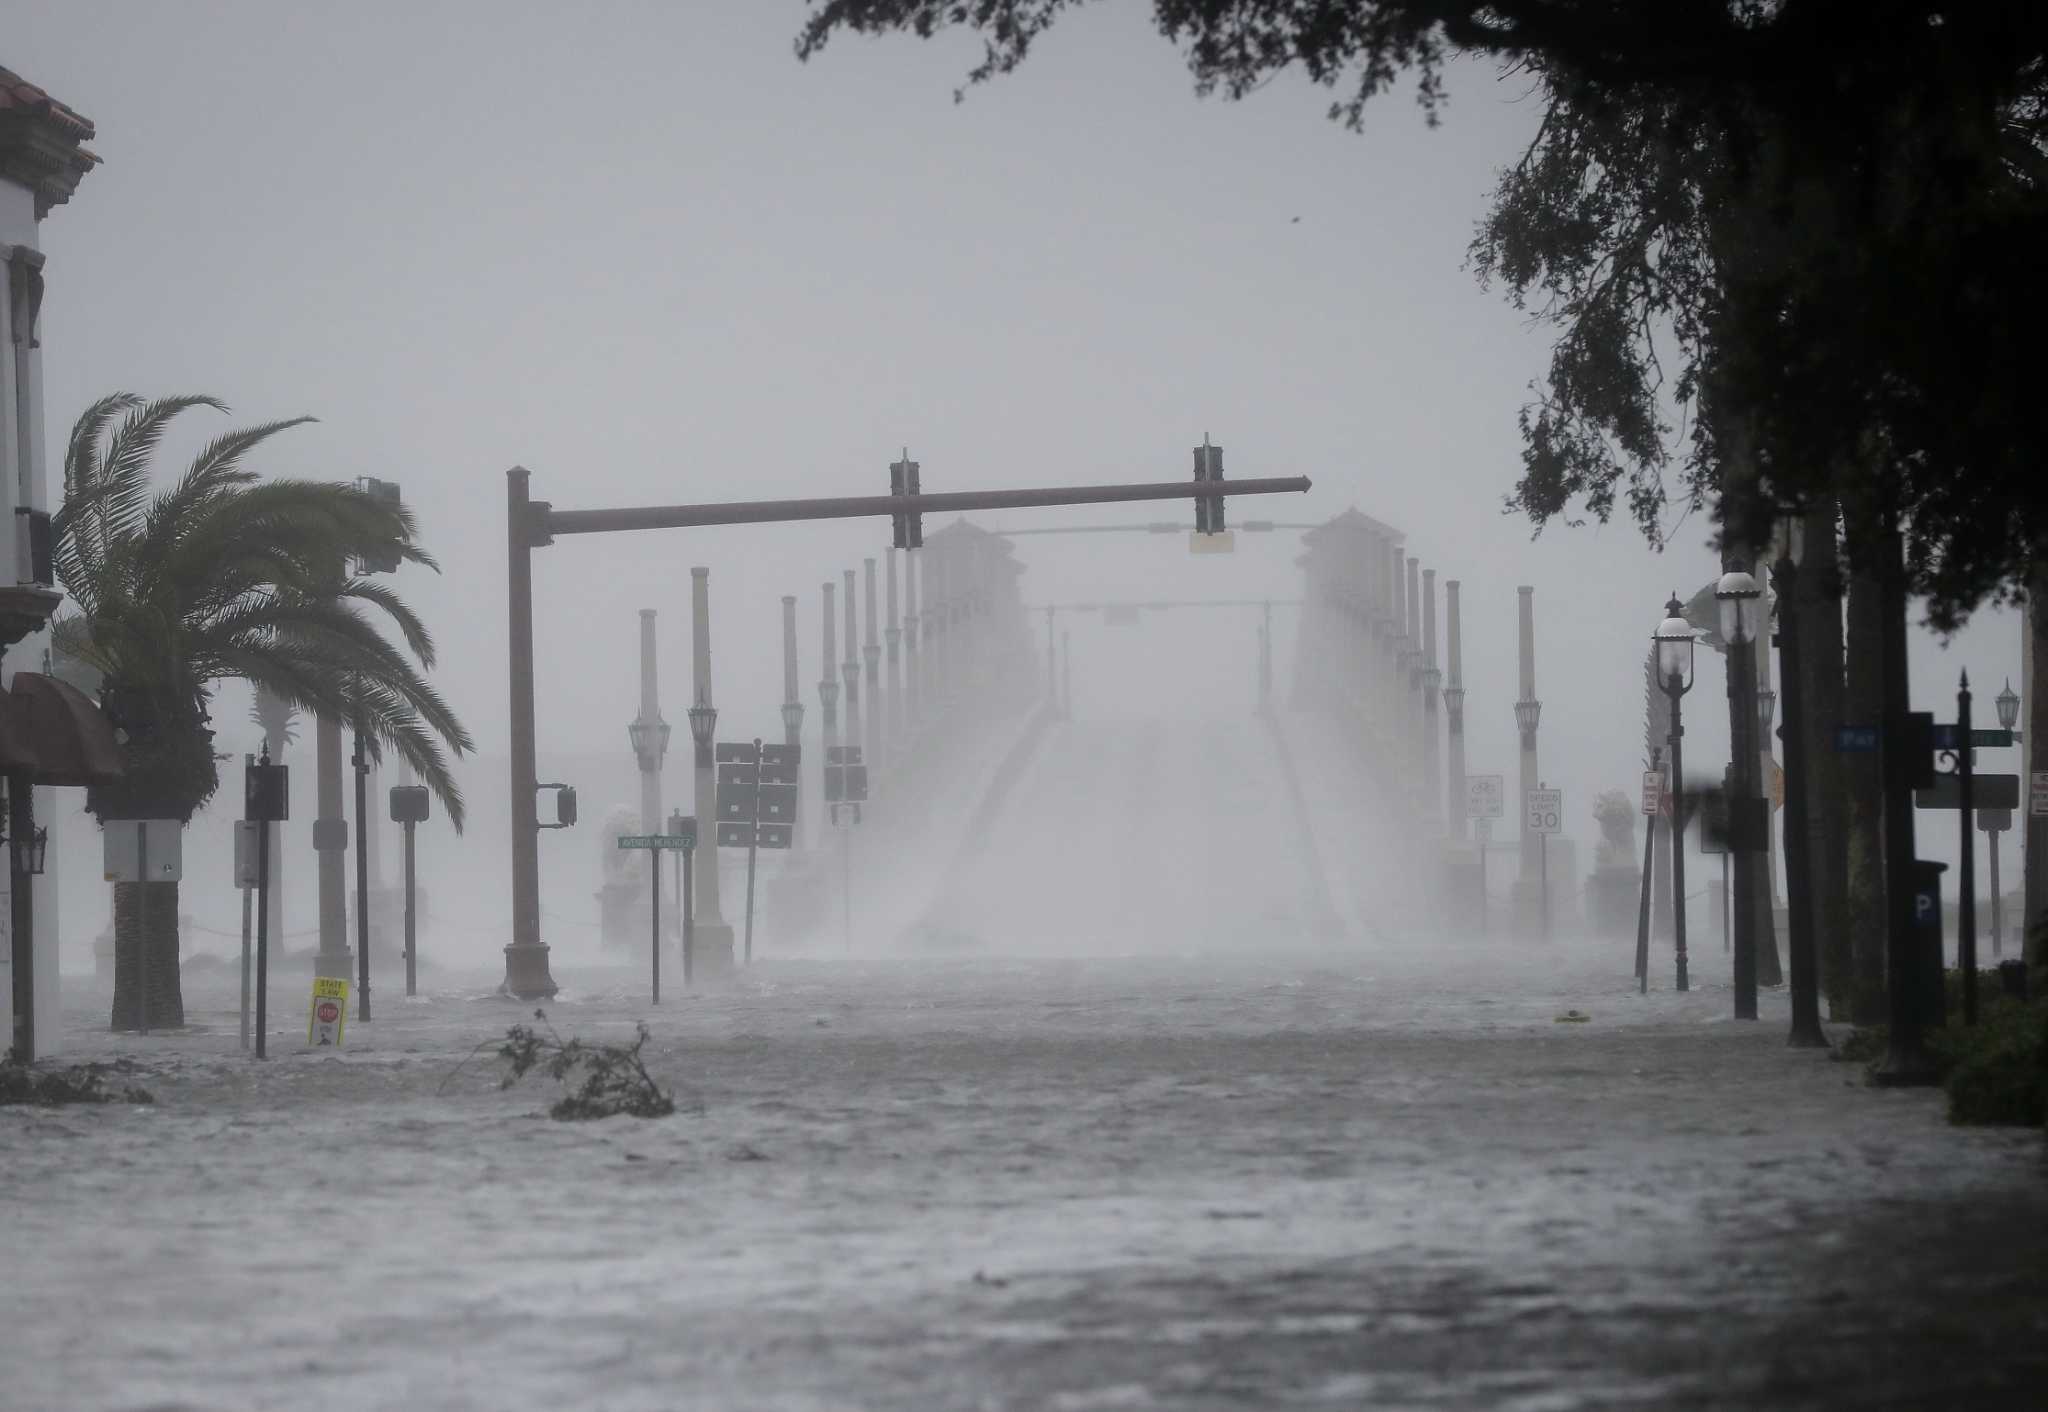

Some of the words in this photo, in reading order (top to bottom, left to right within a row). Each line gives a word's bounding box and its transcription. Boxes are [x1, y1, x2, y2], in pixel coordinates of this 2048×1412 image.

[1529, 793, 1559, 802] SPEED
[1531, 803, 1555, 811] LIMIT
[1530, 812, 1558, 828] 30
[1916, 894, 1932, 919] P
[319, 980, 342, 988] STATE
[319, 1007, 338, 1018] STOP
